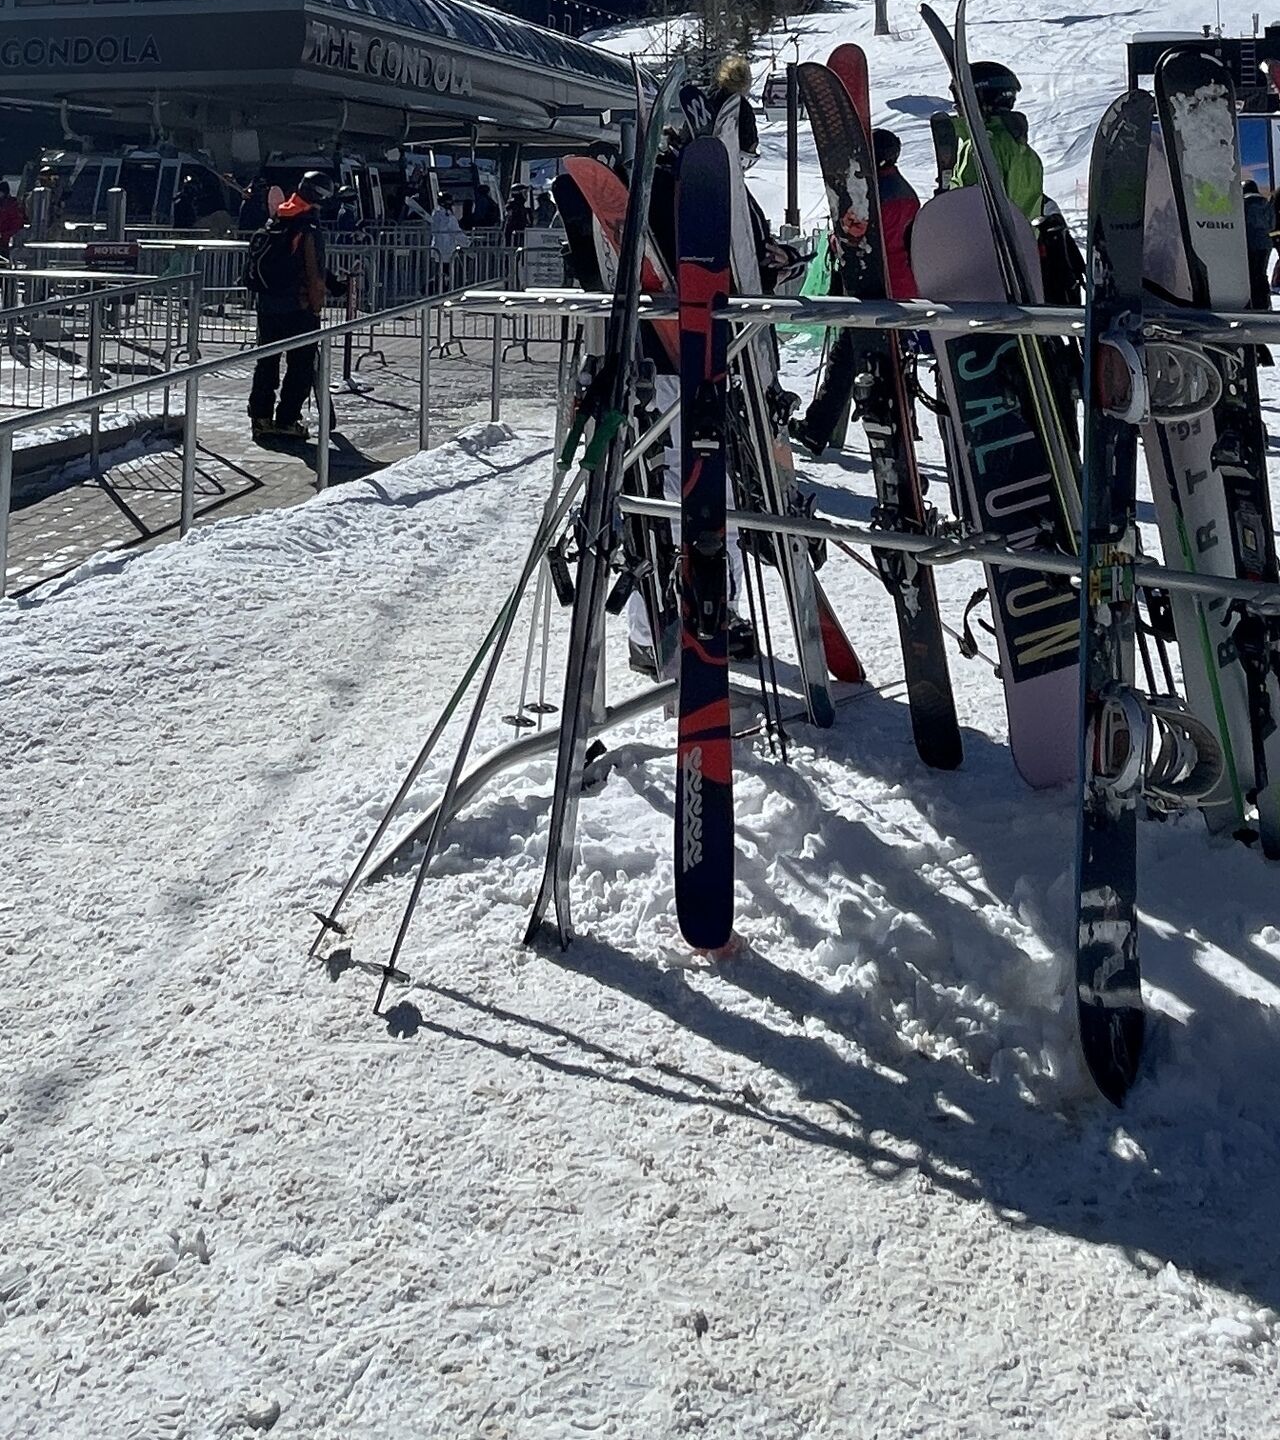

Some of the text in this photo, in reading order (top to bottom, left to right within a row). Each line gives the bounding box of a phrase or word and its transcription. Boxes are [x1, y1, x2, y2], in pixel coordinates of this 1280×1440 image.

[1, 33, 161, 67] GONDOLA
[310, 20, 473, 97] THE GONDOLA
[94, 246, 130, 255] NOTICE
